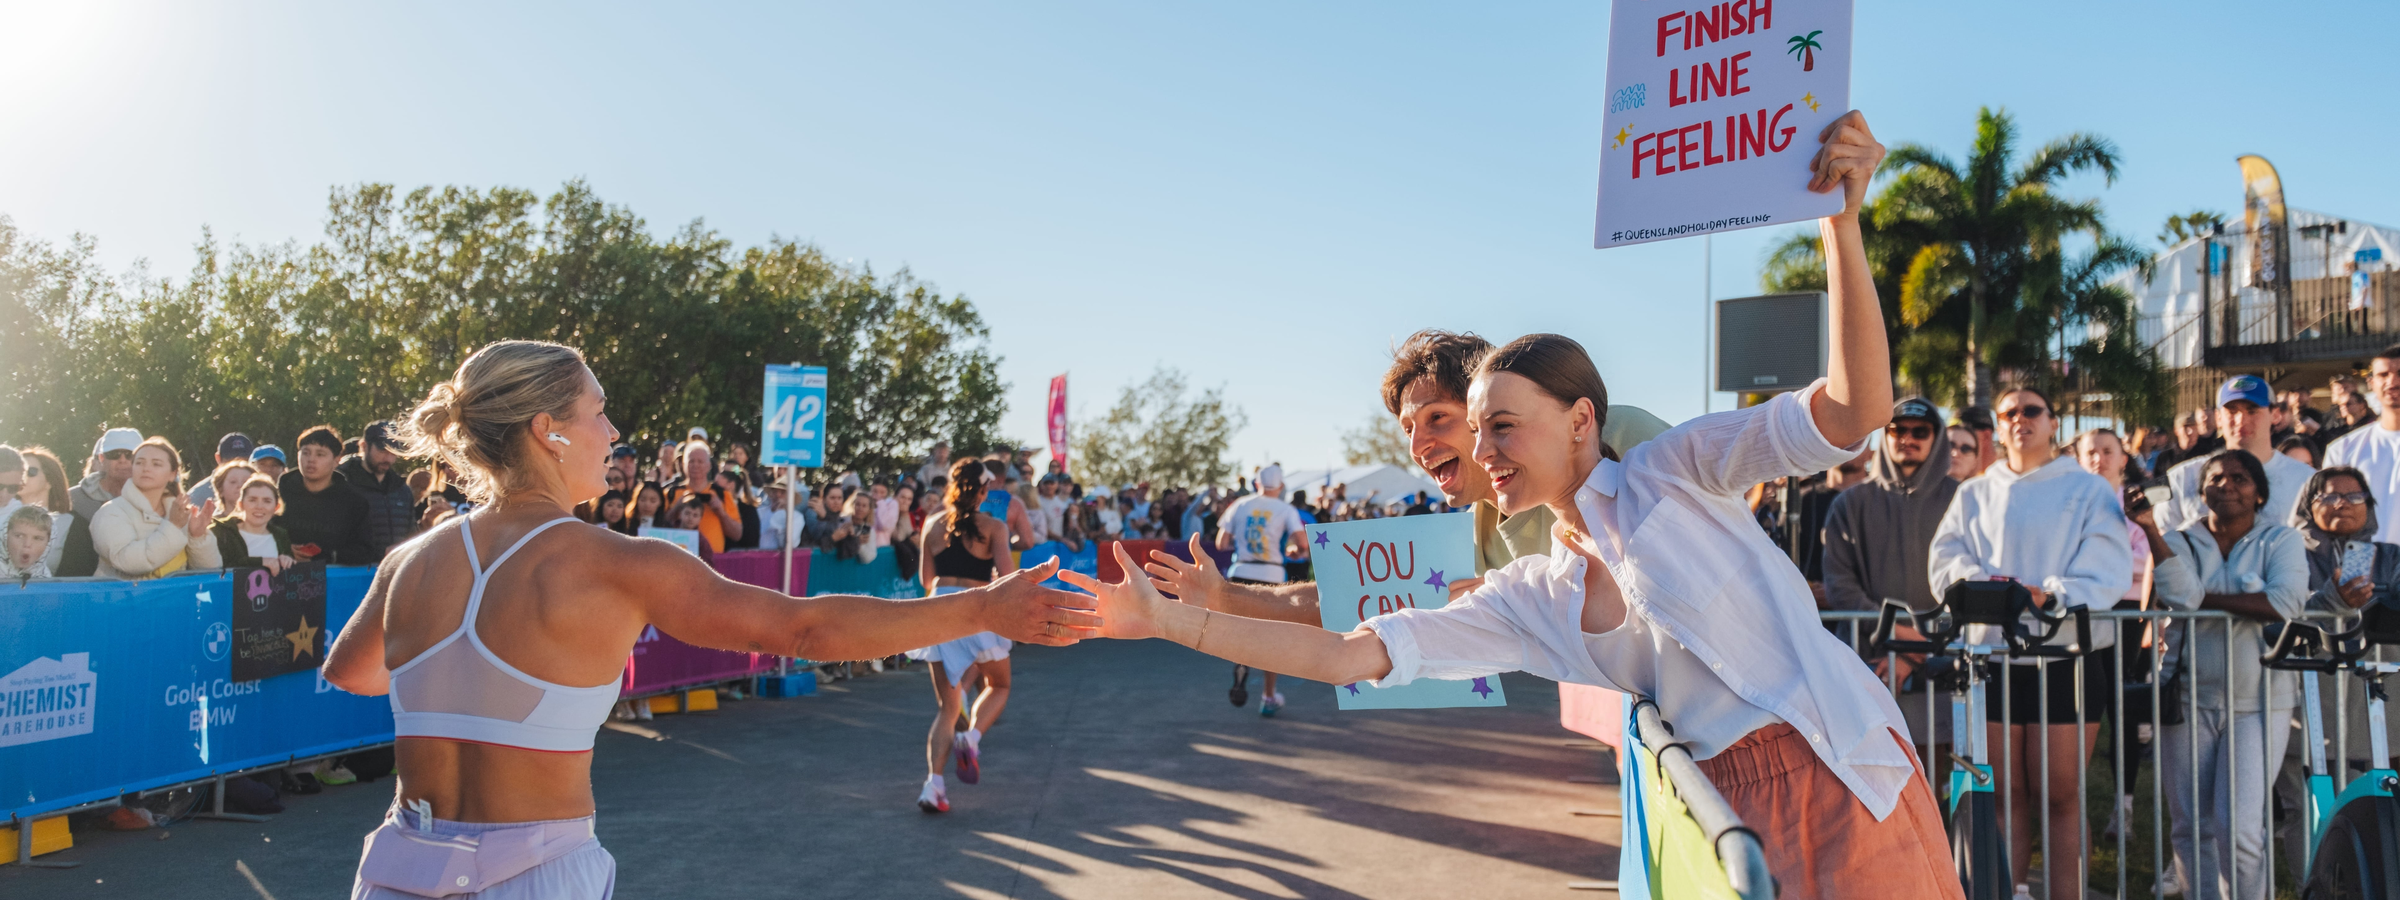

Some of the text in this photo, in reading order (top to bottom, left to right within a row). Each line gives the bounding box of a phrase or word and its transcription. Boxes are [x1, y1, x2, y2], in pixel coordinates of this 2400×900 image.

[1657, 0, 1772, 57] FINISH
[1669, 51, 1751, 107] LINE
[1632, 103, 1797, 179] FEELING
[1611, 214, 1771, 242] #QUEENSLANDHOLIDAYFEELING
[767, 394, 822, 439] 42
[1342, 539, 1415, 586] YOU
[165, 679, 261, 706] Gold Coast
[2, 712, 86, 736] AREHOUSE
[189, 704, 237, 731] BMW
